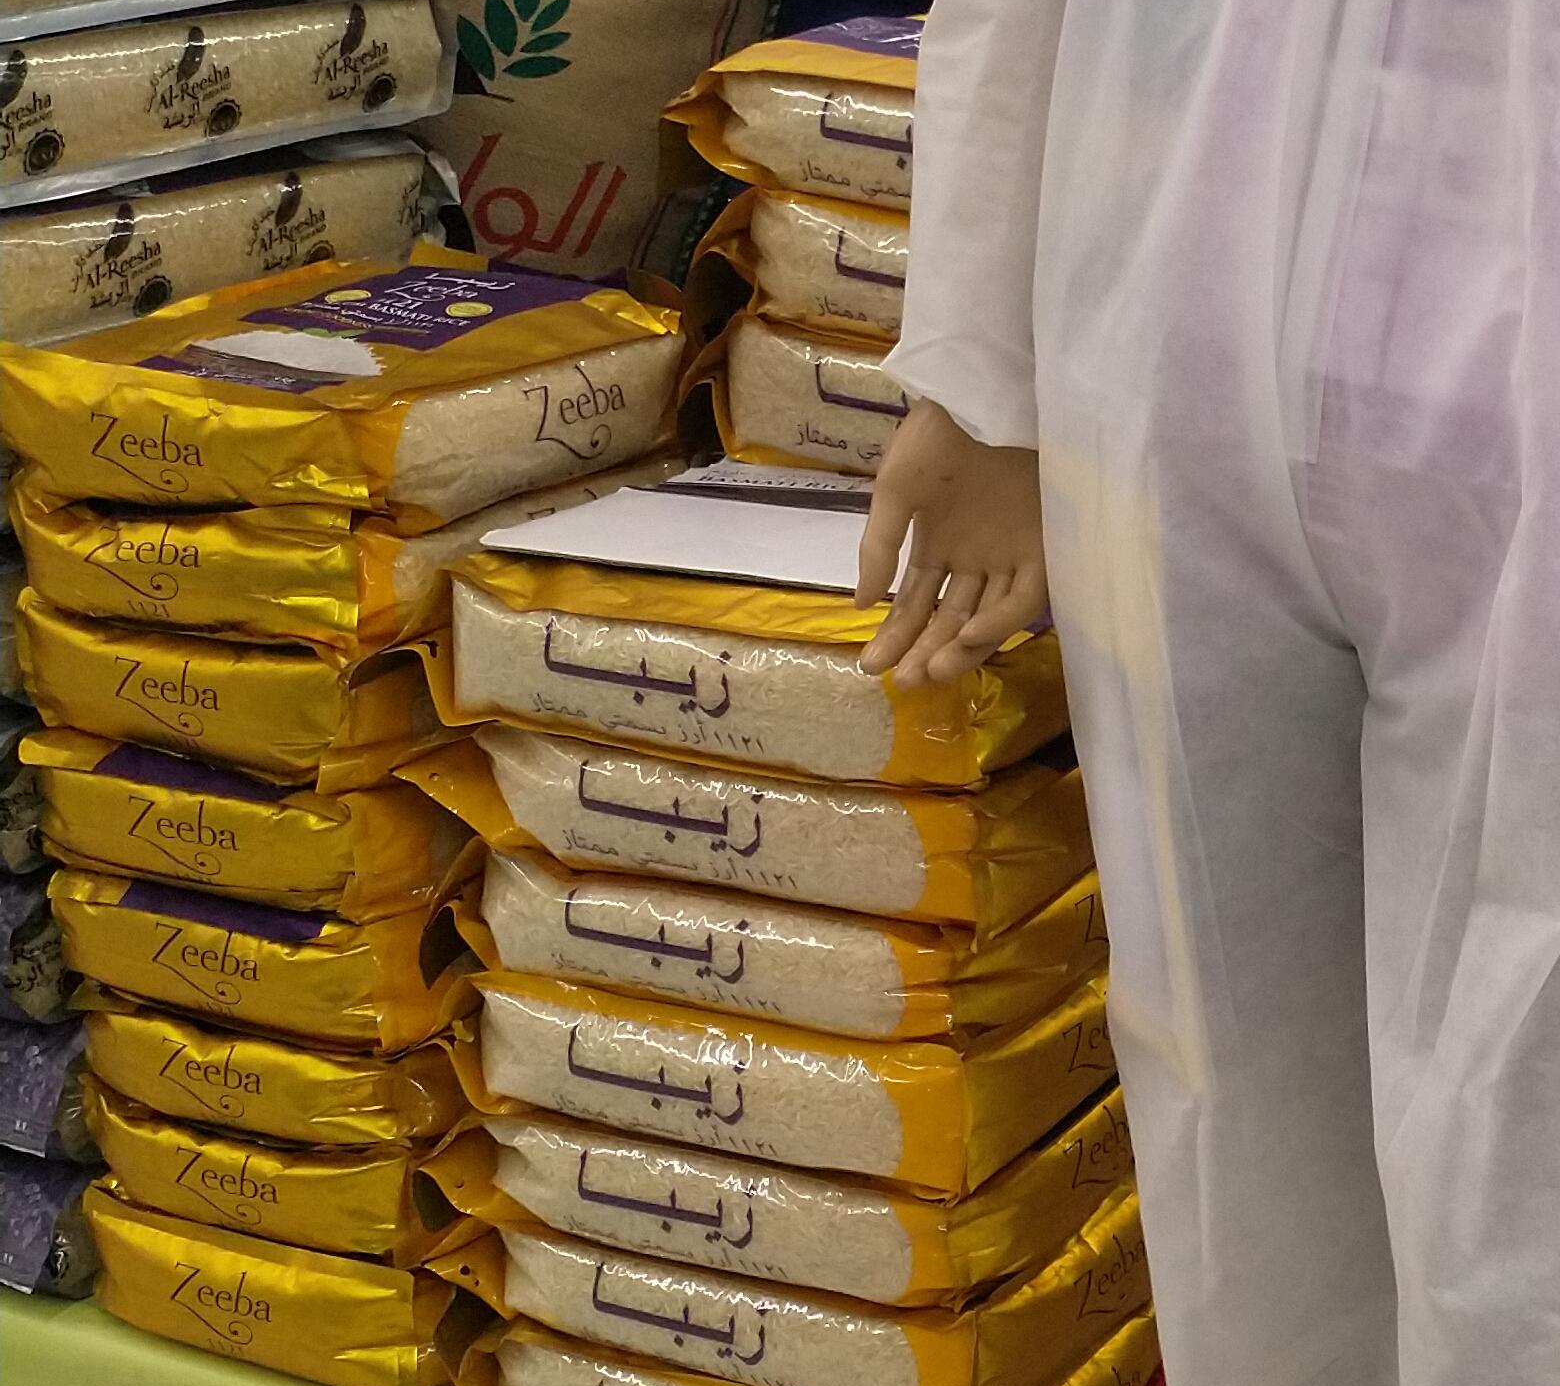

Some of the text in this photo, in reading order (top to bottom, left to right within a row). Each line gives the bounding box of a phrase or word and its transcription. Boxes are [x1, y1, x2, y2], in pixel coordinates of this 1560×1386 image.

[90, 410, 205, 495] Zeeba
[522, 363, 626, 460] Zeeba
[84, 522, 201, 601] Zeeba
[113, 655, 222, 738] Zeeba
[543, 613, 732, 719] زيبا
[127, 795, 240, 876] Zeeba
[578, 758, 763, 858] زيبا
[152, 921, 263, 1005] Zeeba
[565, 887, 746, 984] زيبا
[158, 1036, 264, 1119] Zeeba
[568, 1023, 745, 1124] زيبا
[175, 1146, 281, 1226] Zeeba
[1064, 1103, 1131, 1191] Zeeb
[579, 1148, 754, 1248] زيبا
[170, 1260, 273, 1346] Zeeba
[592, 1262, 767, 1366] زيبا
